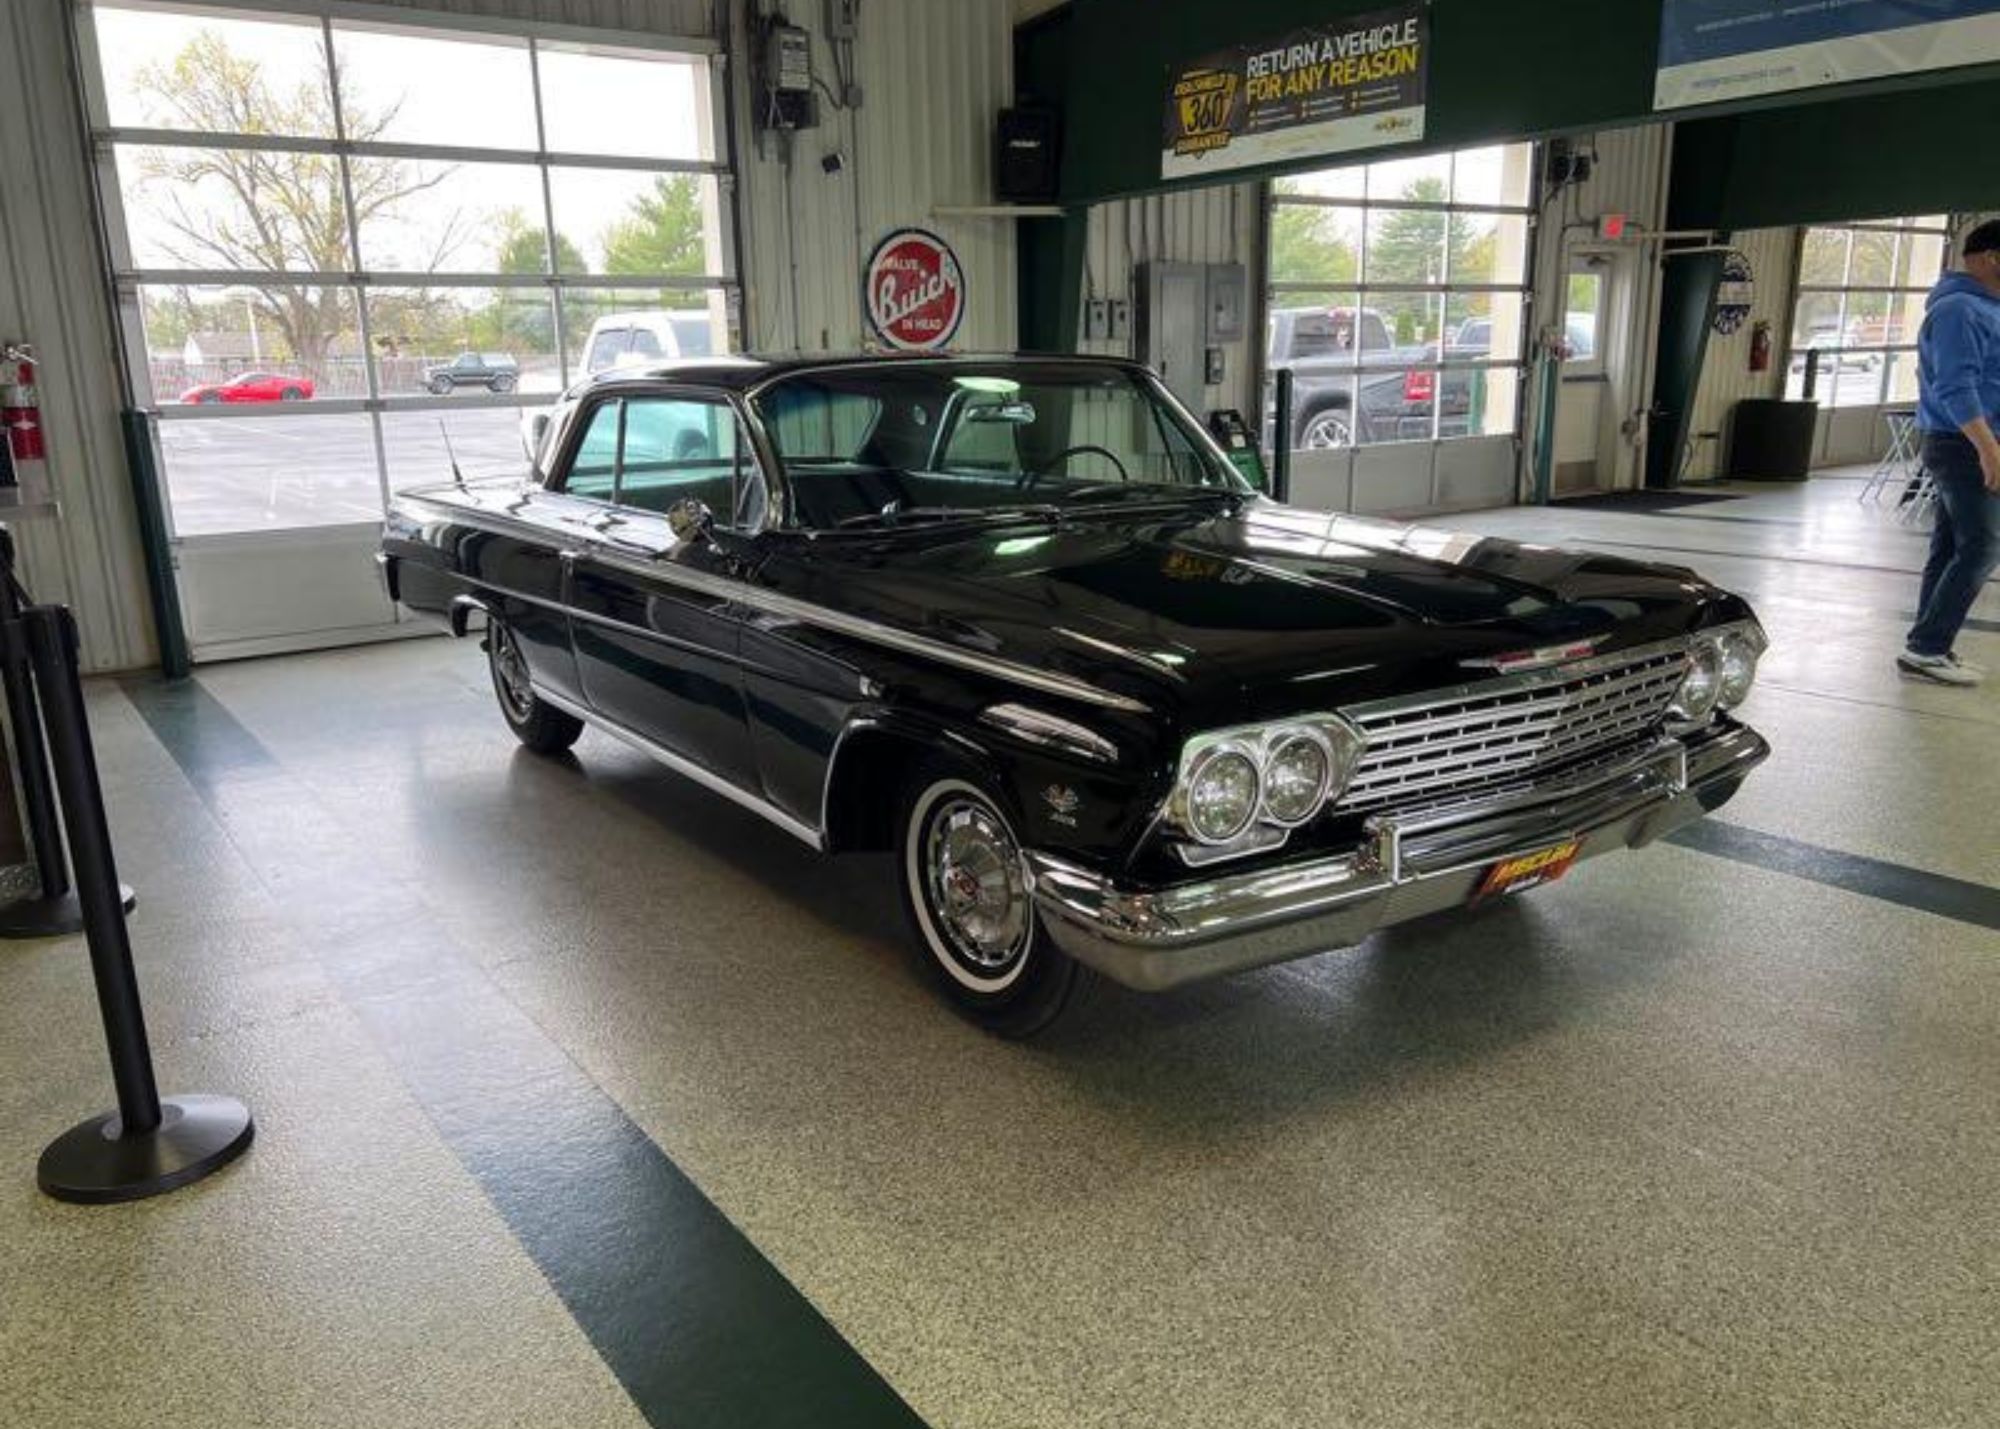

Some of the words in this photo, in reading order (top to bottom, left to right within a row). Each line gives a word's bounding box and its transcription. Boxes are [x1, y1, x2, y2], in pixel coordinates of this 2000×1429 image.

[1246, 76, 1281, 104] FOR
[1286, 64, 1331, 97] ANY
[1329, 46, 1418, 87] REASON
[1247, 40, 1317, 79] RETURN
[1321, 37, 1334, 60] A
[1334, 19, 1418, 56] VEHICLE
[1187, 92, 1223, 132] 360
[877, 248, 957, 329] Buick
